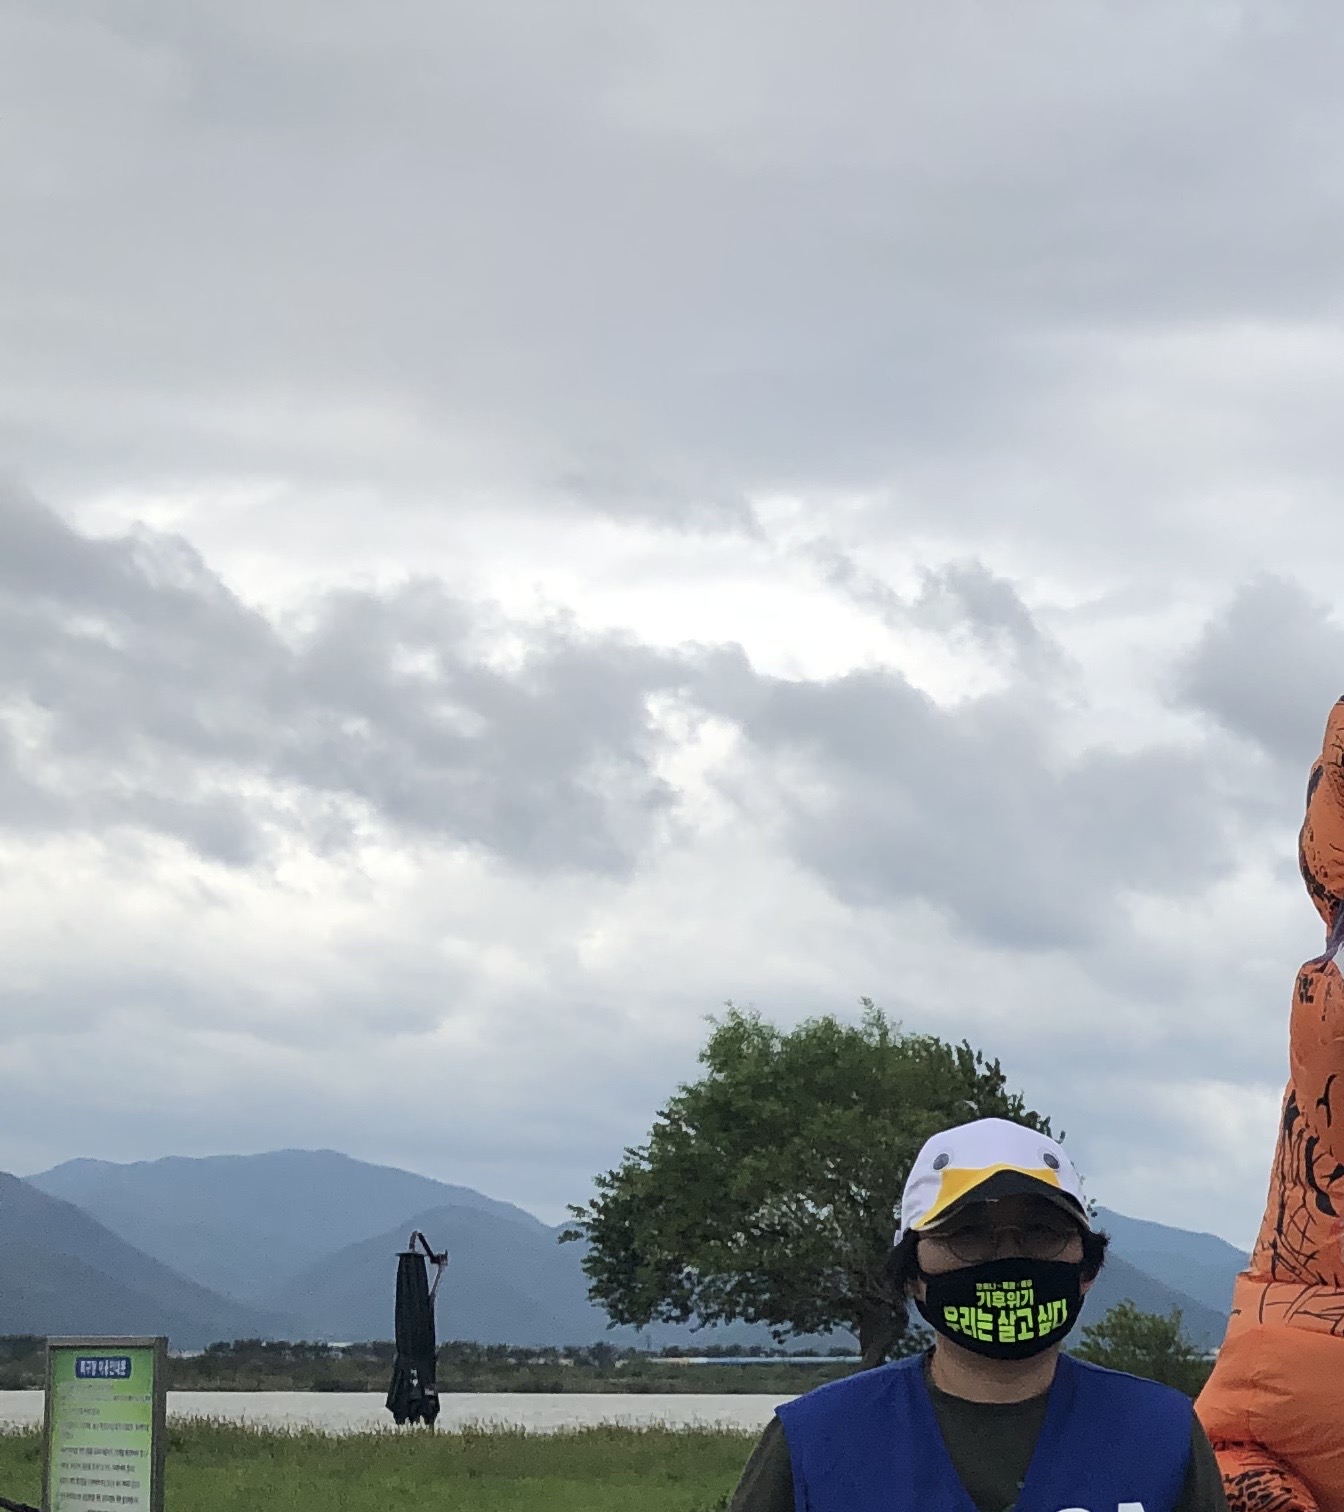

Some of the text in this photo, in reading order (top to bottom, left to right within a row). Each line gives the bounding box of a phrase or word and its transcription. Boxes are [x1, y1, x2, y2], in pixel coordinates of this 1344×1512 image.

[976, 1288, 1034, 1308] 기후위기
[943, 1298, 1068, 1343] 우리는 살고 싶다
